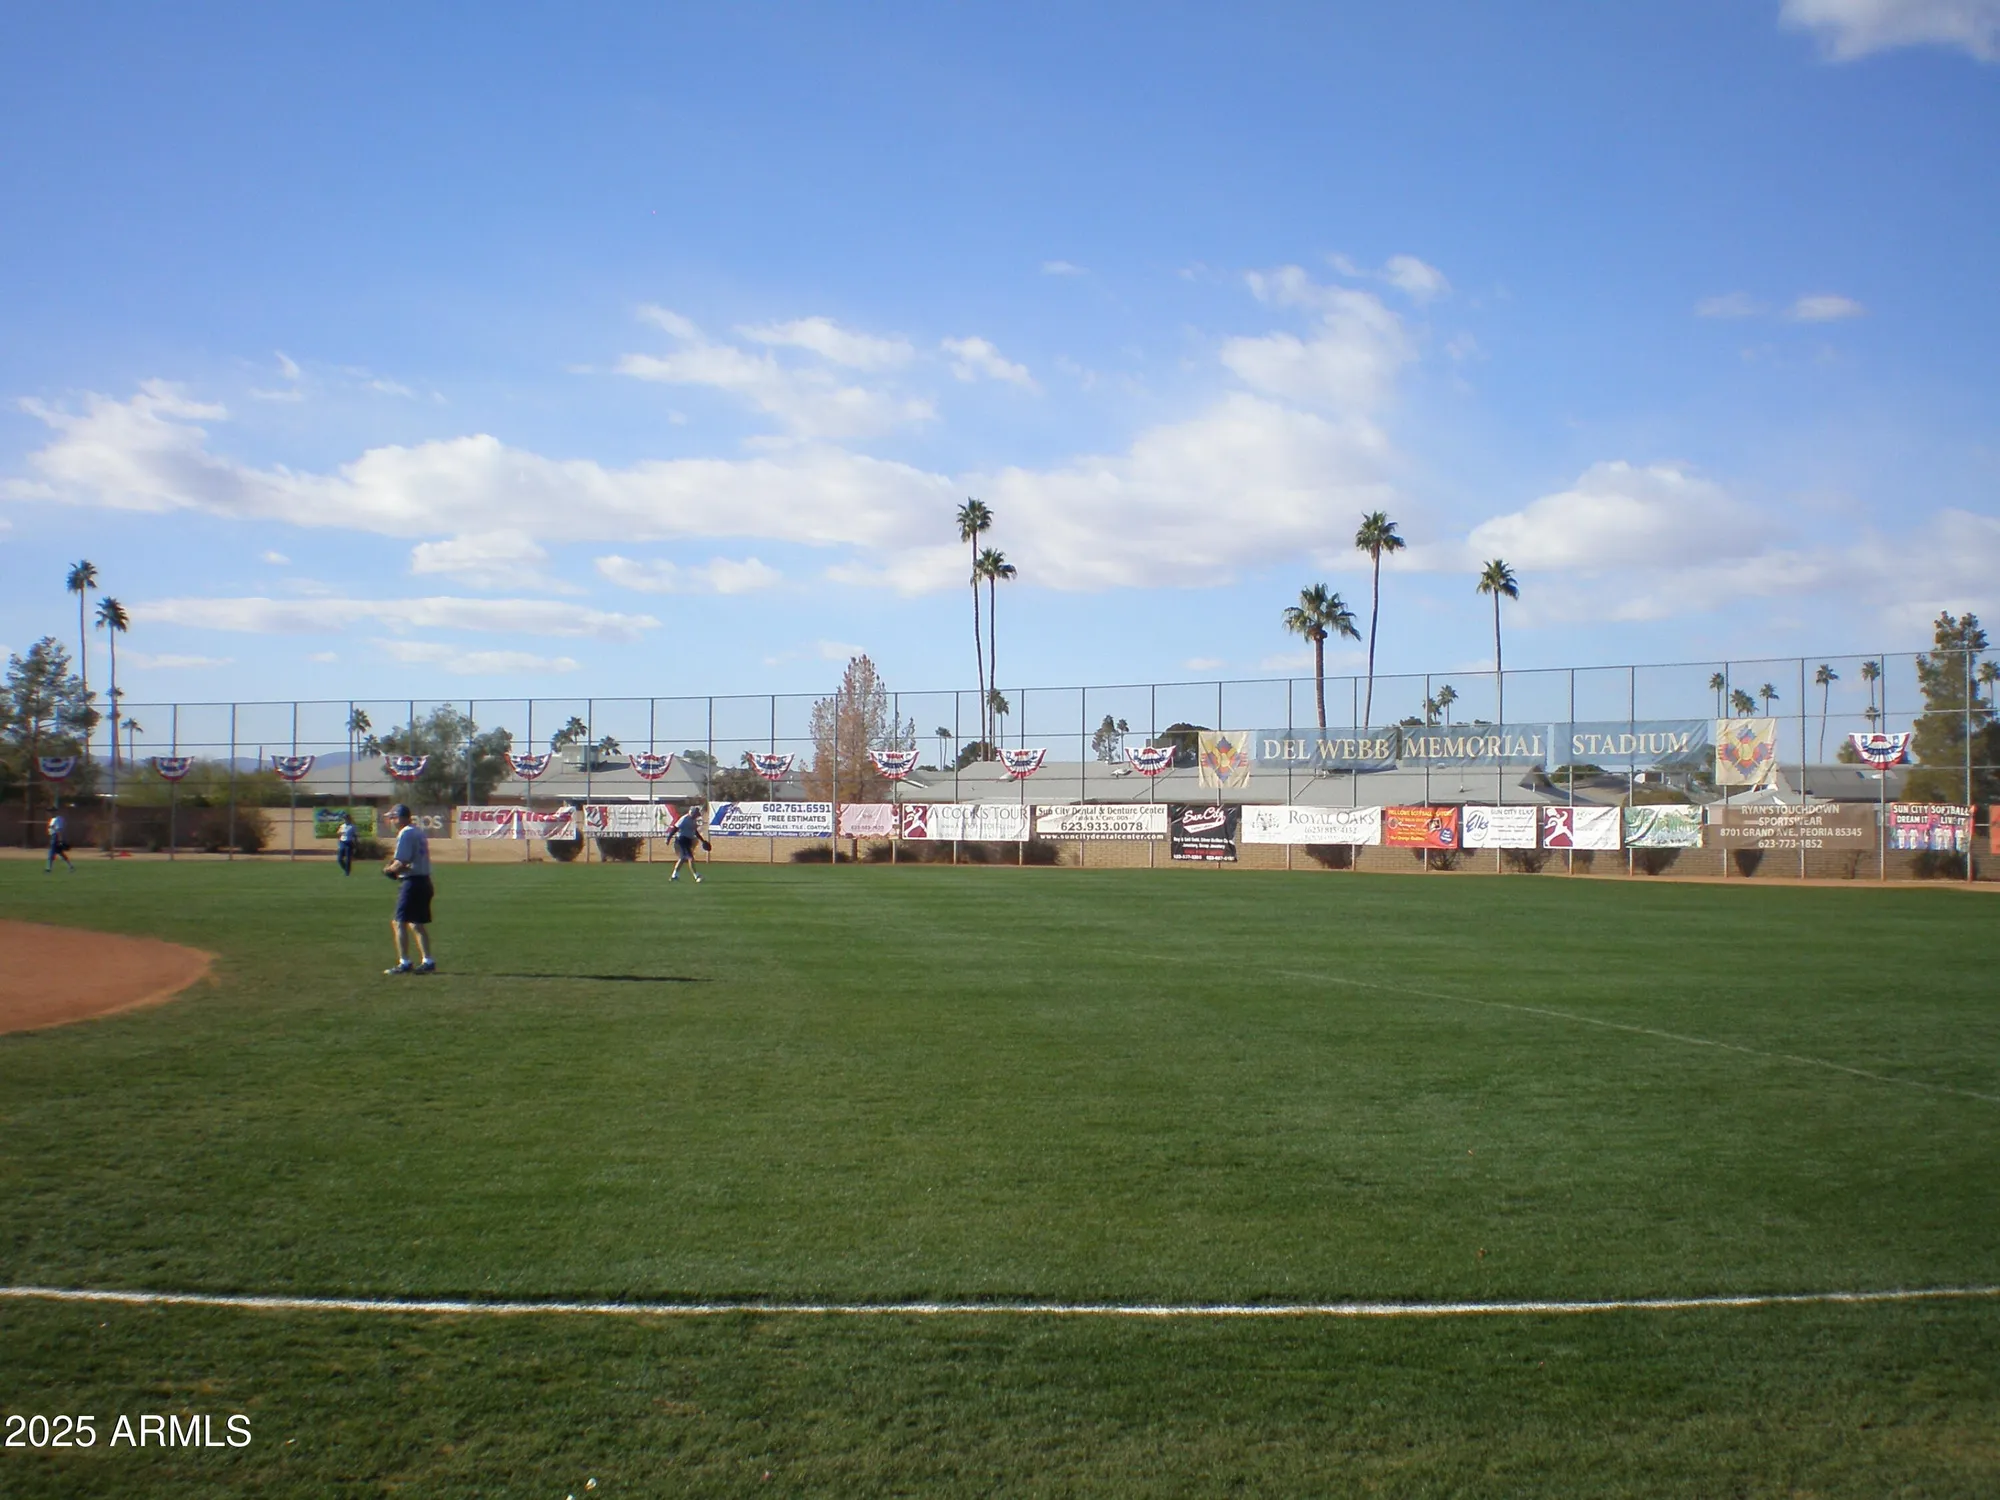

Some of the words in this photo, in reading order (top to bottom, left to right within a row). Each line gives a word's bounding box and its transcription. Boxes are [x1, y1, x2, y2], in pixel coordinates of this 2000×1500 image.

[1263, 739, 1310, 760] DEL
[1316, 738, 1389, 760] WEBB
[1404, 735, 1545, 758] MEMORIAL
[1572, 733, 1690, 756] STADIUM
[762, 803, 832, 813] 602.761.6591
[990, 807, 1028, 820] TOUR
[1038, 807, 1053, 815] Sun
[1055, 807, 1070, 815] City
[1072, 807, 1097, 815] Dental
[1139, 806, 1165, 814] Center
[1741, 805, 1774, 815] RYAN'S
[1776, 804, 1840, 815] TOUCHDOWN
[1893, 805, 1909, 814] SUN
[1911, 804, 1928, 814] CITY
[1930, 806, 1970, 816] SOFTBALL
[460, 810, 495, 822] BIG
[787, 815, 827, 823] ESTIMATES
[1182, 810, 1204, 823] Sun
[1896, 815, 1920, 824] DREAM
[1921, 815, 1929, 824] IT
[1957, 817, 1966, 826] IT
[1060, 822, 1143, 831] 623.933.0078
[1466, 814, 1489, 832] Elks
[1720, 828, 1740, 837] 8701
[1742, 828, 1775, 837] GRAND
[1800, 828, 1834, 837] PEORIA
[1835, 828, 1863, 837] 85345
[1758, 839, 1823, 849] 623-773-1852
